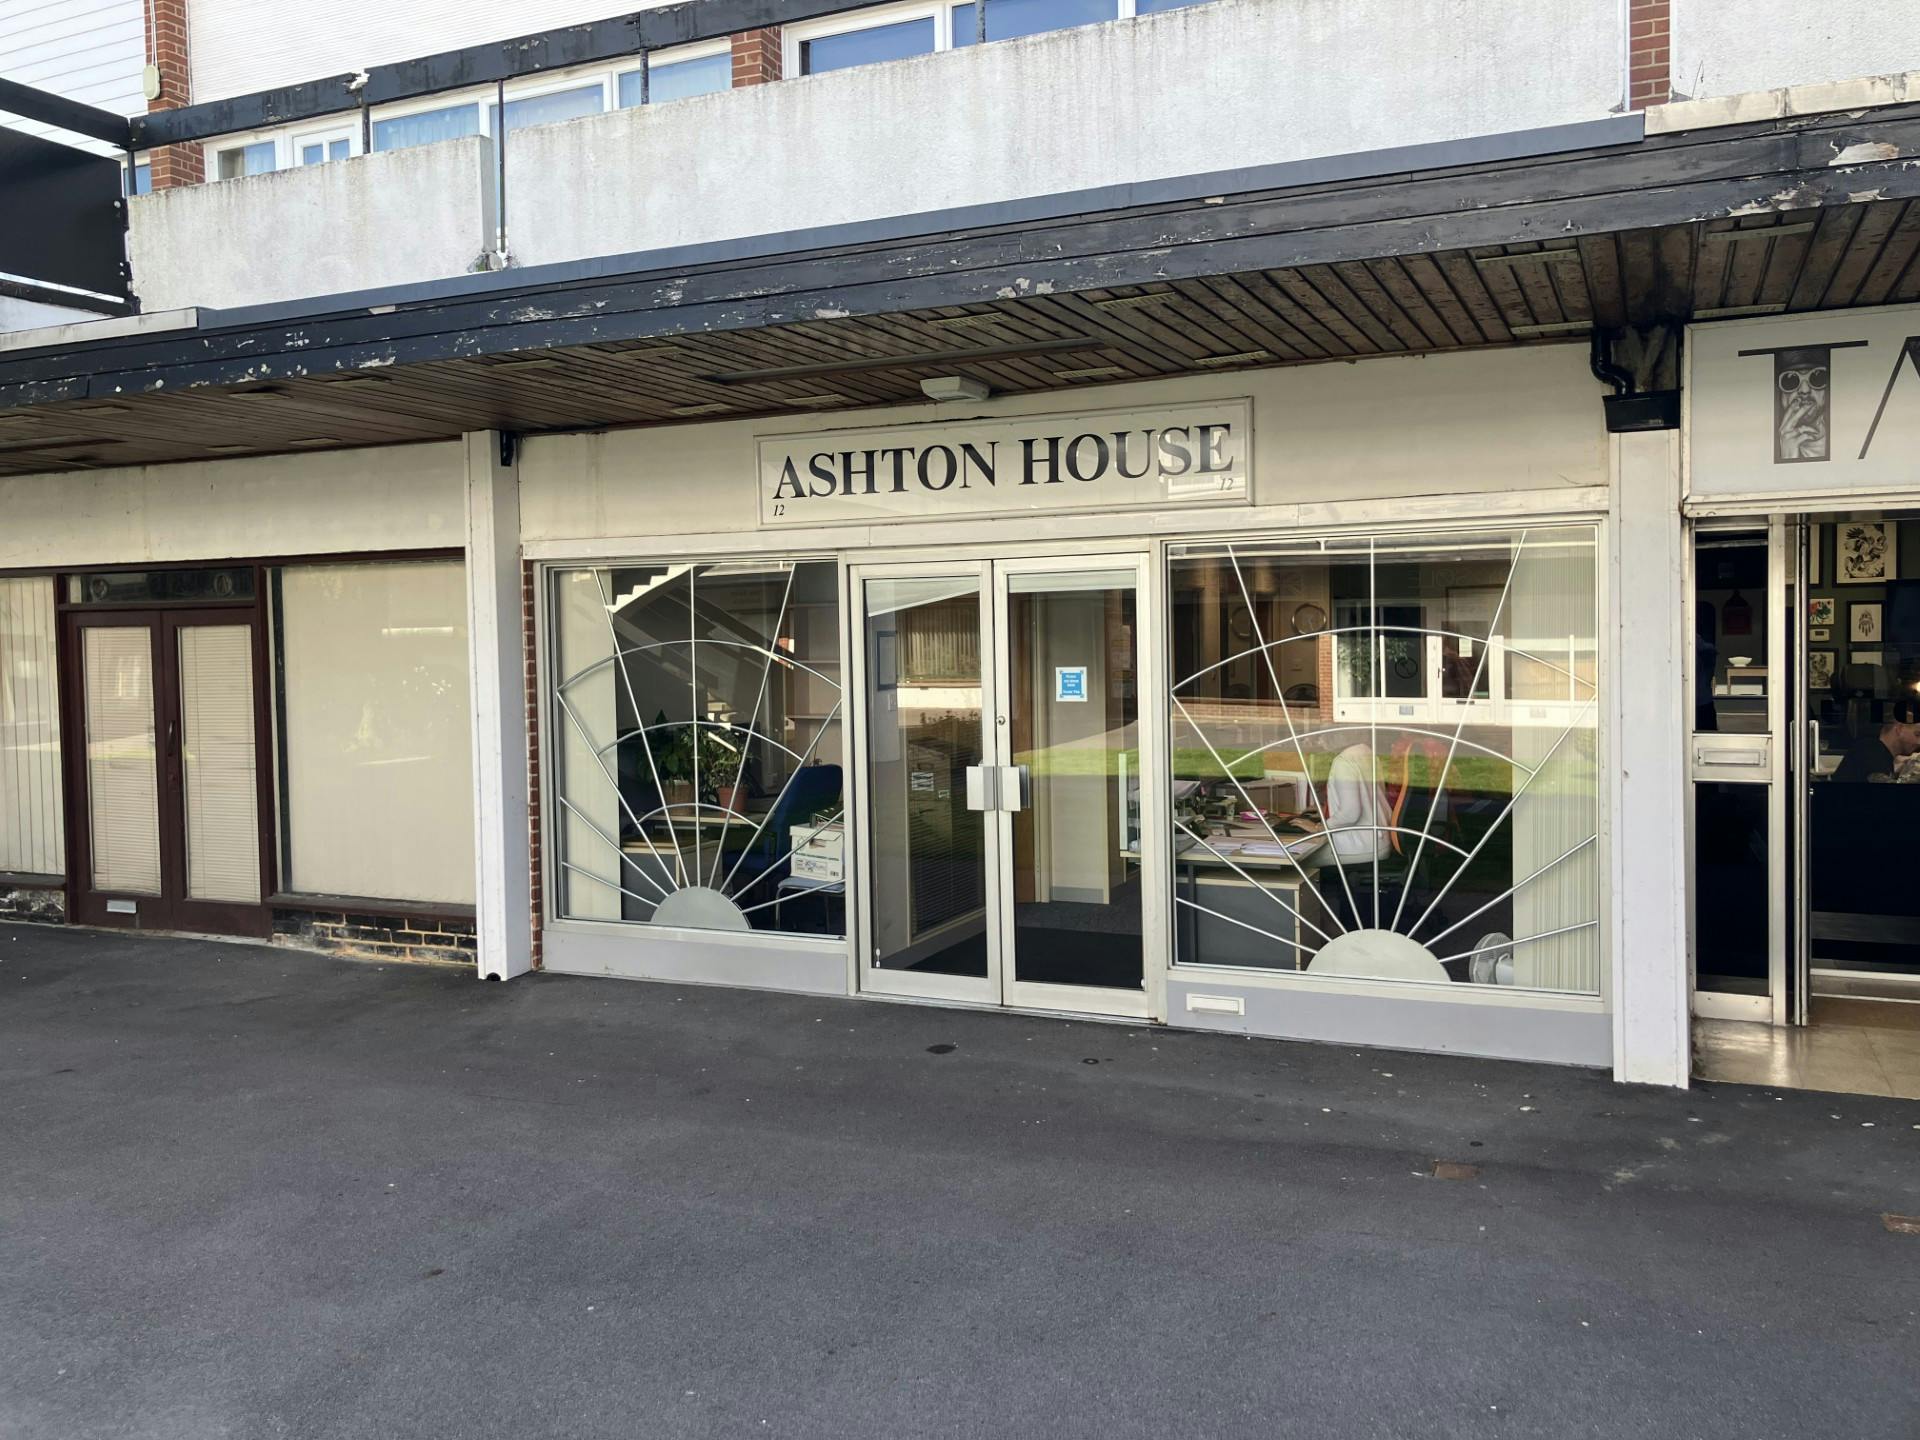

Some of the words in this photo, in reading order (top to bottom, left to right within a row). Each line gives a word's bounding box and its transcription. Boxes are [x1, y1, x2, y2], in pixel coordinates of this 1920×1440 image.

[773, 441, 999, 499] ASHTON
[1018, 423, 1234, 486] HOUSE
[1219, 476, 1234, 492] 12
[772, 504, 786, 518] 12
